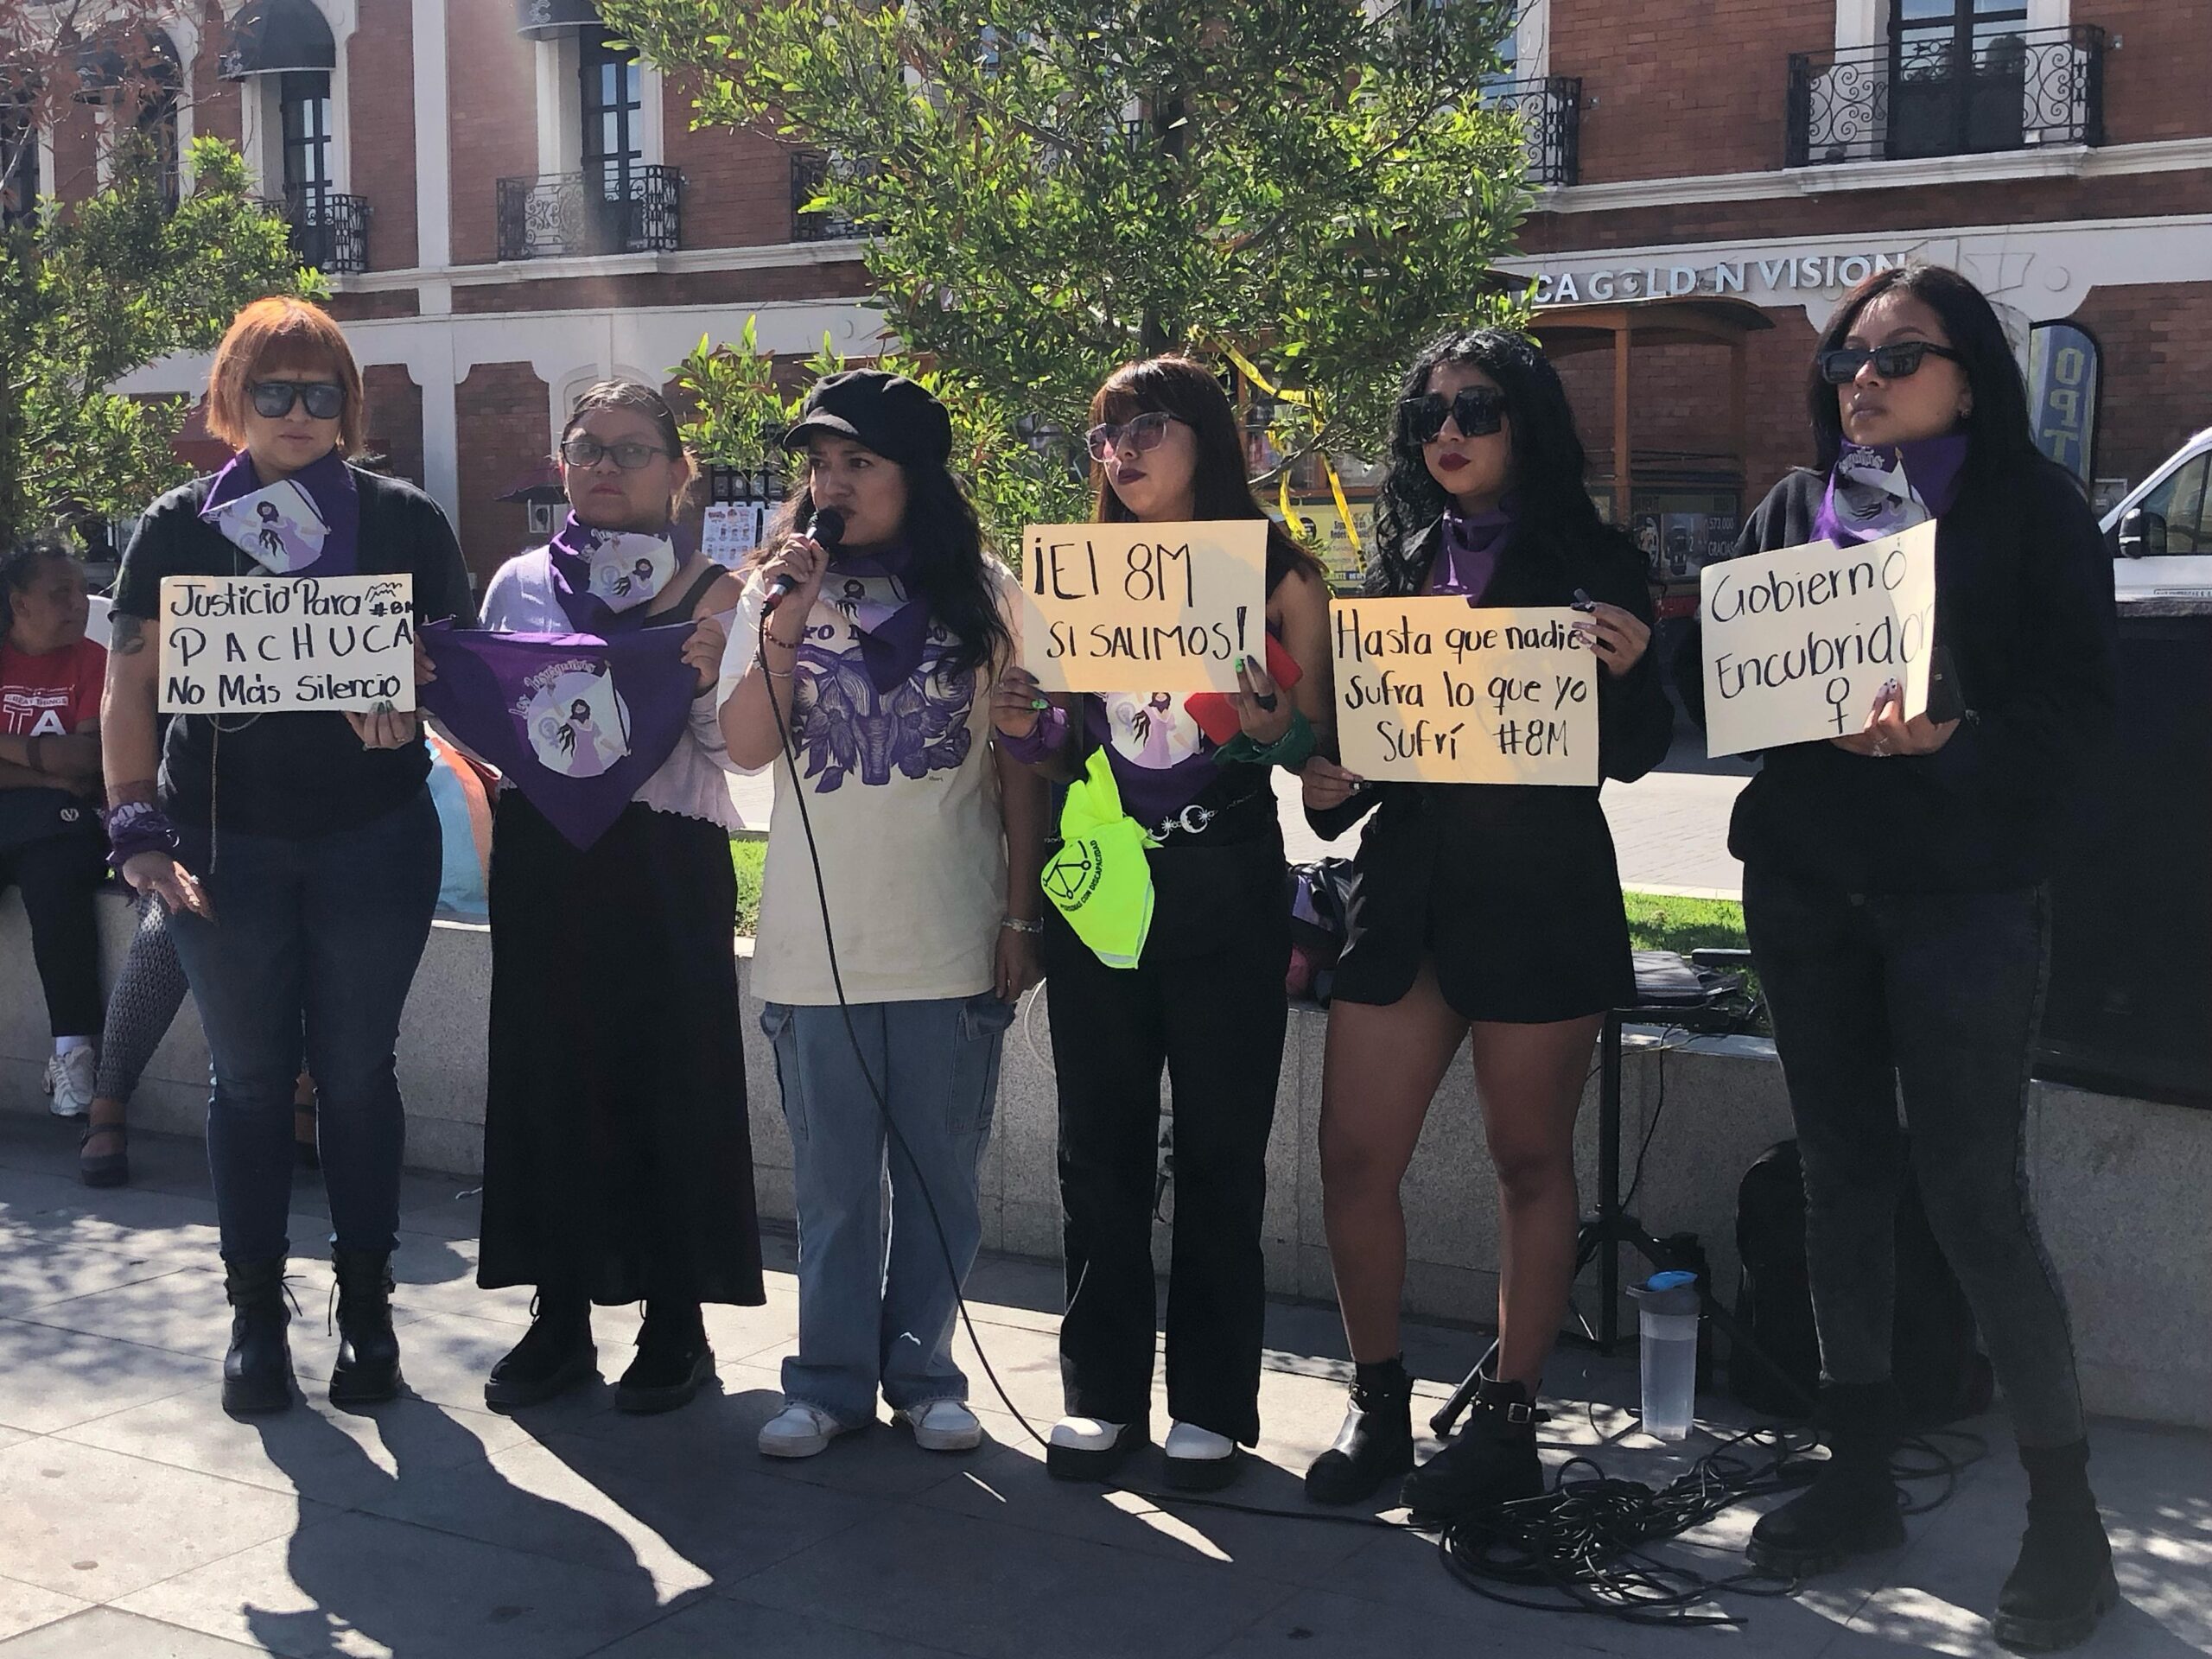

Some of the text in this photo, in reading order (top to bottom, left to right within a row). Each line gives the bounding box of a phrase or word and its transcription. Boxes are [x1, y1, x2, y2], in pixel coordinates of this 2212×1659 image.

[170, 577, 361, 617] Justicia Para
[1124, 543, 1193, 607] 8M
[1712, 550, 1907, 622] Gobierno
[169, 618, 414, 666] PACHUCA
[1046, 606, 1248, 666] SI SALIMOS!
[1337, 608, 1582, 664] Hasta que nadie
[1715, 603, 1934, 699] Encubridor
[167, 674, 401, 707] No Más Silencio
[1443, 671, 1475, 707] lo
[1487, 677, 1541, 715] que
[1555, 675, 1587, 710] yo
[1376, 719, 1568, 762] Sufrí #8M
